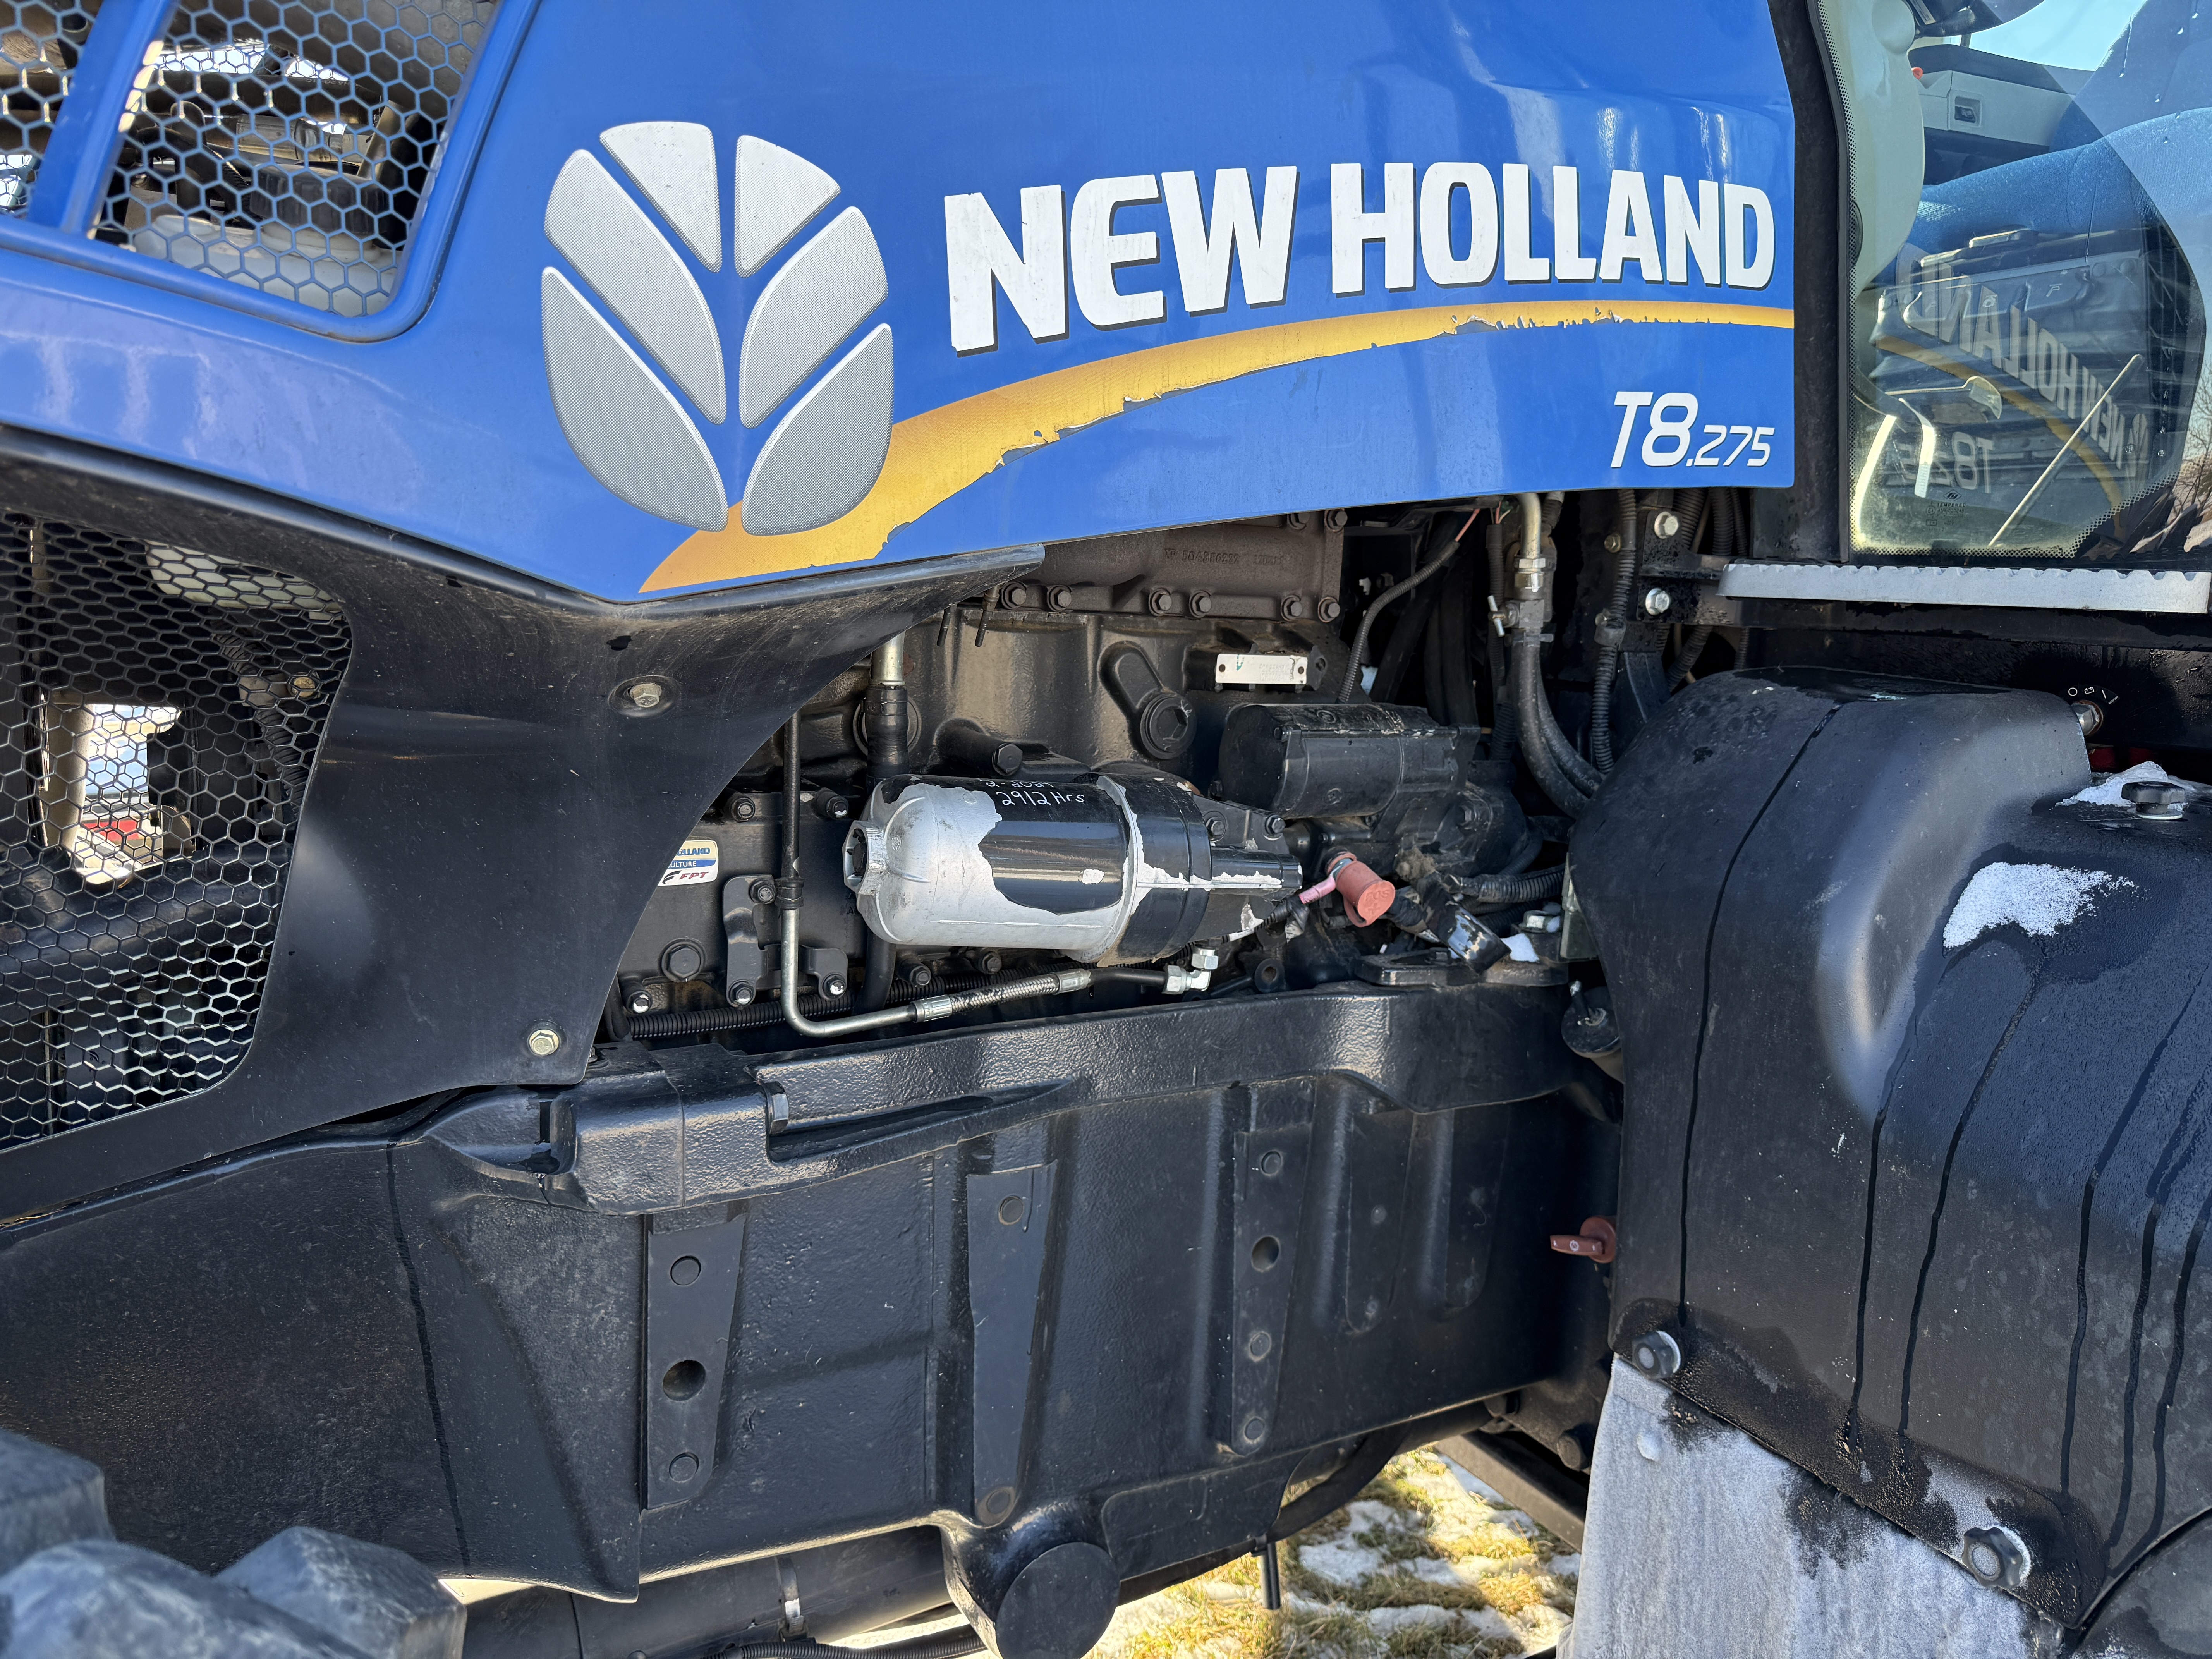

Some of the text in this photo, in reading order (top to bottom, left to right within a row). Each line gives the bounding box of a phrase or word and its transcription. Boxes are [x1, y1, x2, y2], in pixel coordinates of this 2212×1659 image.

[944, 161, 1776, 357] NEW HOLLAND
[1611, 391, 1775, 467] T8.275
[996, 791, 1085, 806] 2912 Hrs
[677, 847, 711, 856] OLLAND
[679, 871, 709, 880] FPT
